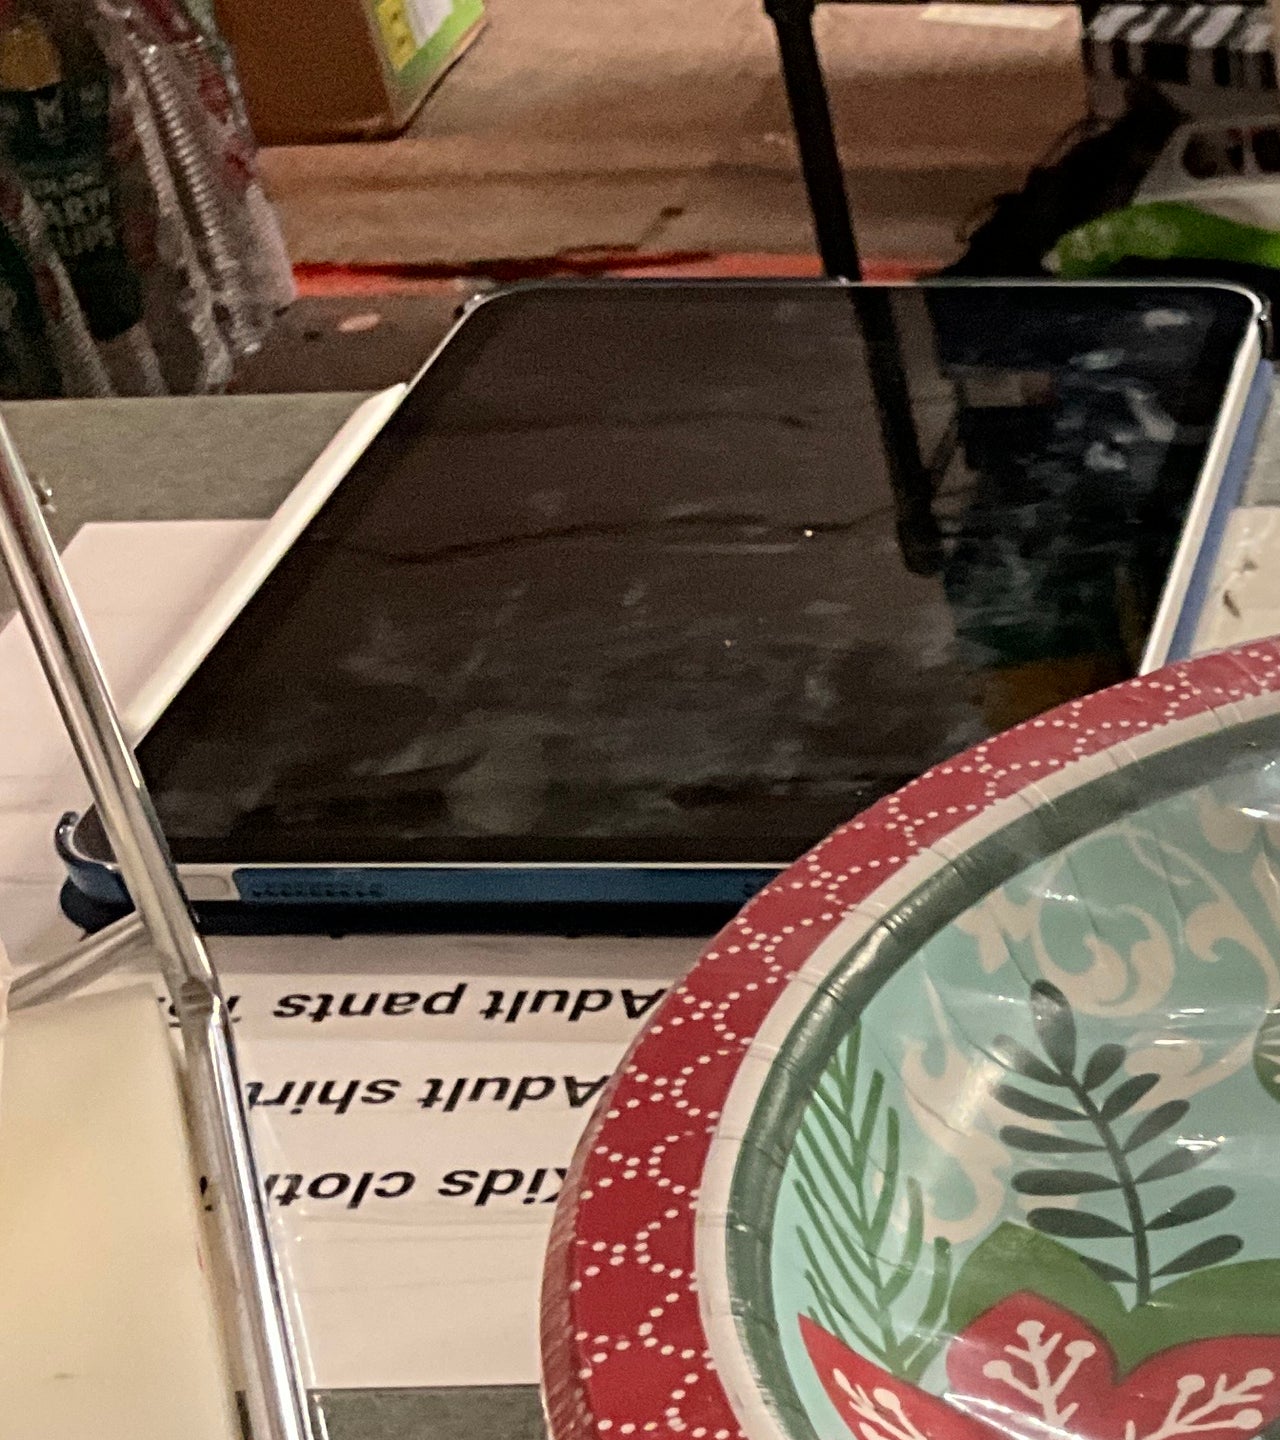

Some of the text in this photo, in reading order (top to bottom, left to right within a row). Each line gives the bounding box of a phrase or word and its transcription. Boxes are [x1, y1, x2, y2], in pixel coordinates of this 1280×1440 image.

[272, 983, 468, 1023] pants
[479, 988, 668, 1024] Adult
[417, 1075, 613, 1113] Adult
